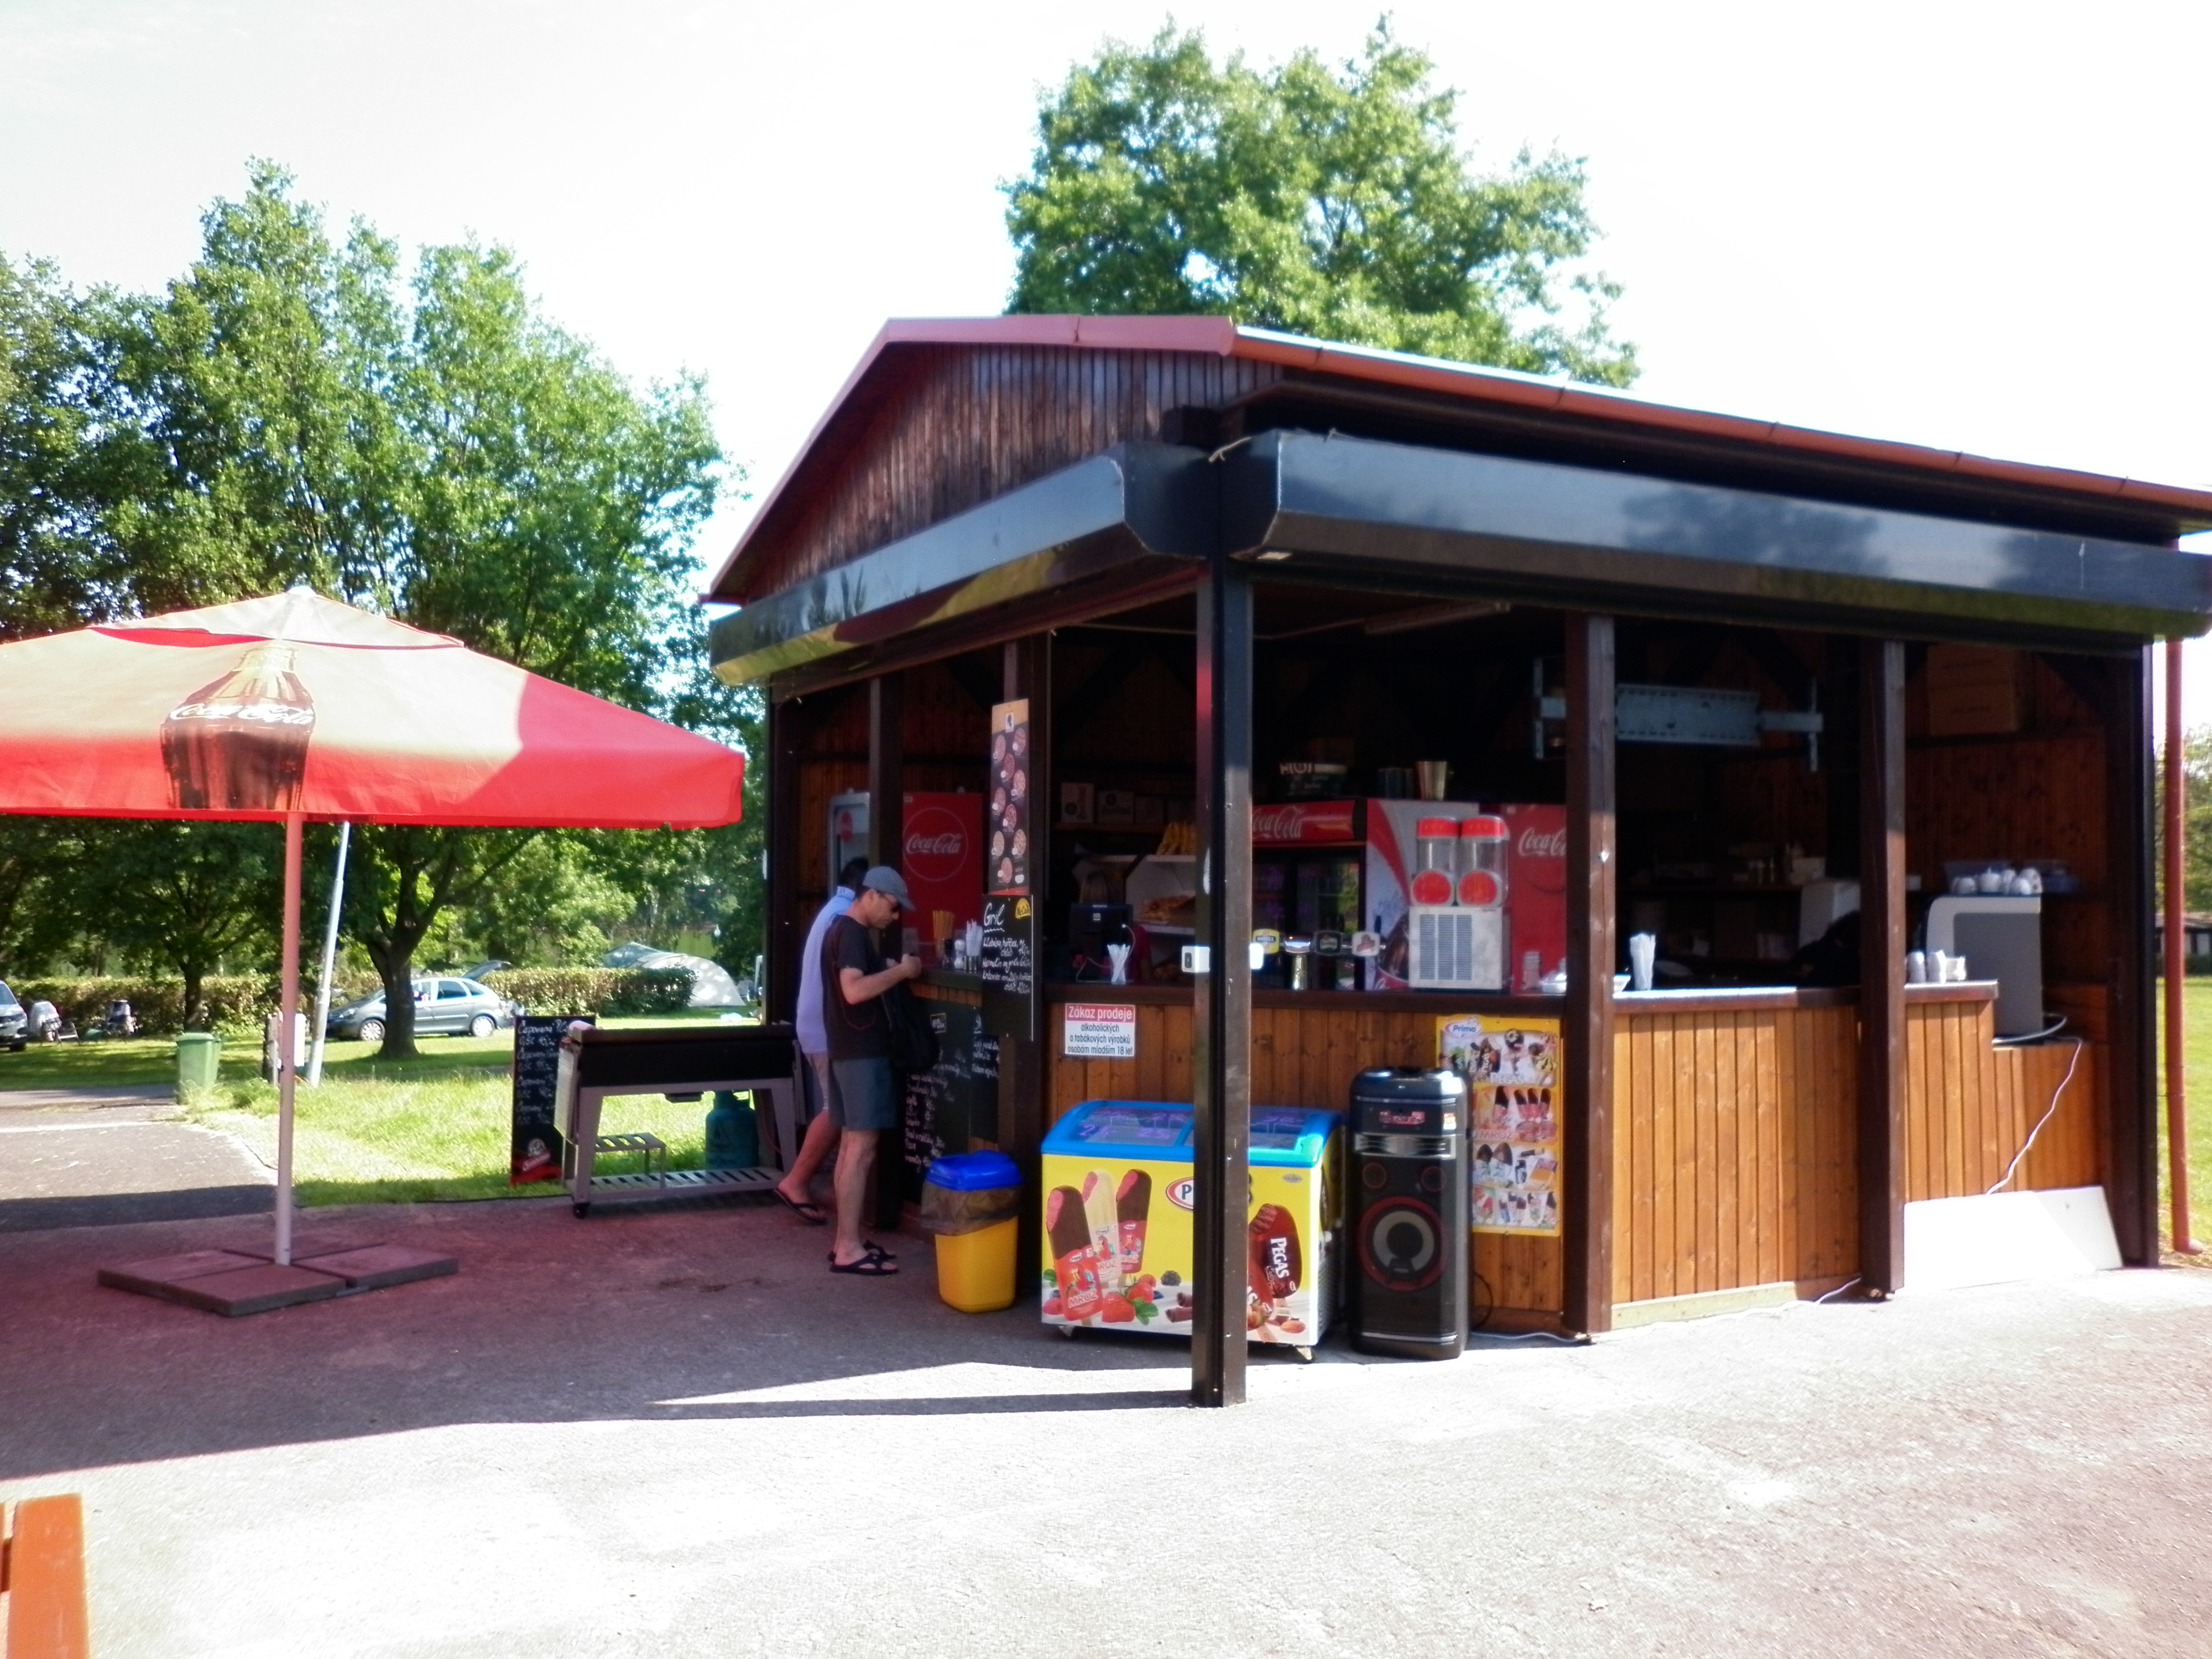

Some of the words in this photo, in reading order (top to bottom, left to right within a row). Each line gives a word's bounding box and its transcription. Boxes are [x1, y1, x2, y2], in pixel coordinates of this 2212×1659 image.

[906, 833, 962, 854] Coca-Cola
[984, 902, 1004, 926] Gril
[1068, 1005, 1095, 1019] Zákaz
[1097, 1008, 1133, 1022] prodeje
[1081, 1023, 1119, 1034] alkoholických
[1074, 1034, 1107, 1044] tabákových
[1108, 1034, 1131, 1045] výrobků
[1068, 1045, 1089, 1053] osobám
[1091, 1045, 1115, 1054] mladším
[1117, 1046, 1124, 1055] 18
[1270, 1237, 1290, 1279] PEGAS
